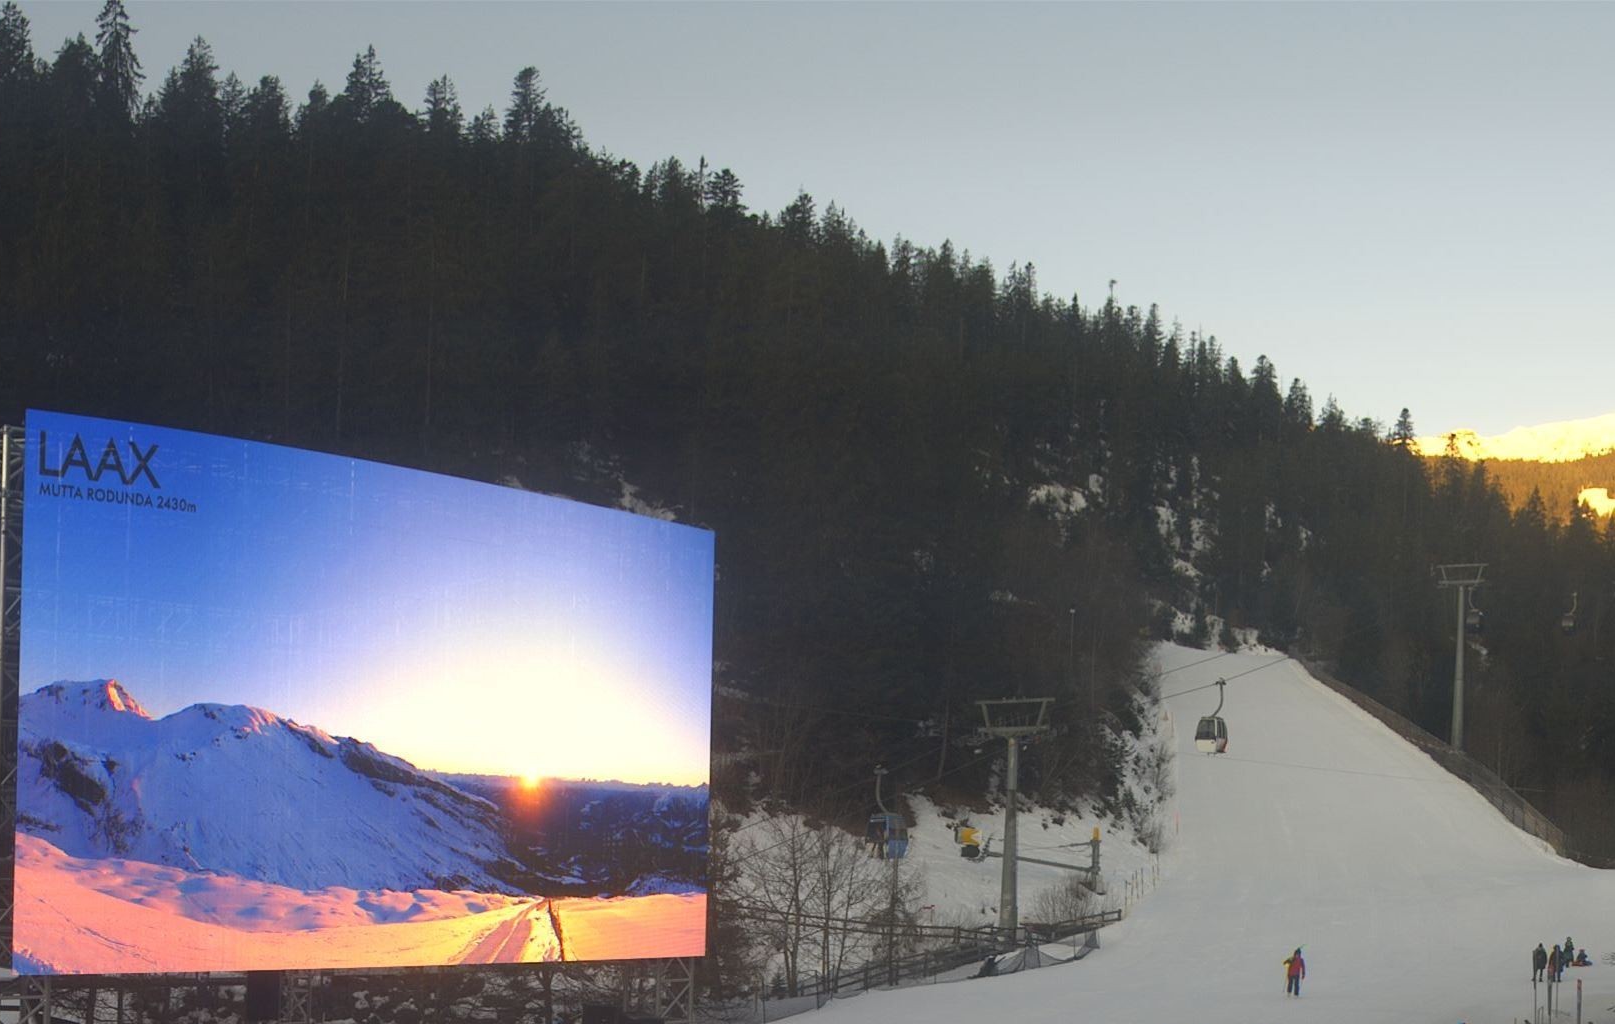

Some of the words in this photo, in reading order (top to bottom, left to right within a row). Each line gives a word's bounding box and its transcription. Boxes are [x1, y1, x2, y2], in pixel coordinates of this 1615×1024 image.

[39, 430, 161, 489] LAAX
[39, 482, 84, 500] MUTTA
[87, 488, 154, 508] RODUNDA
[157, 496, 197, 513] 2430m
